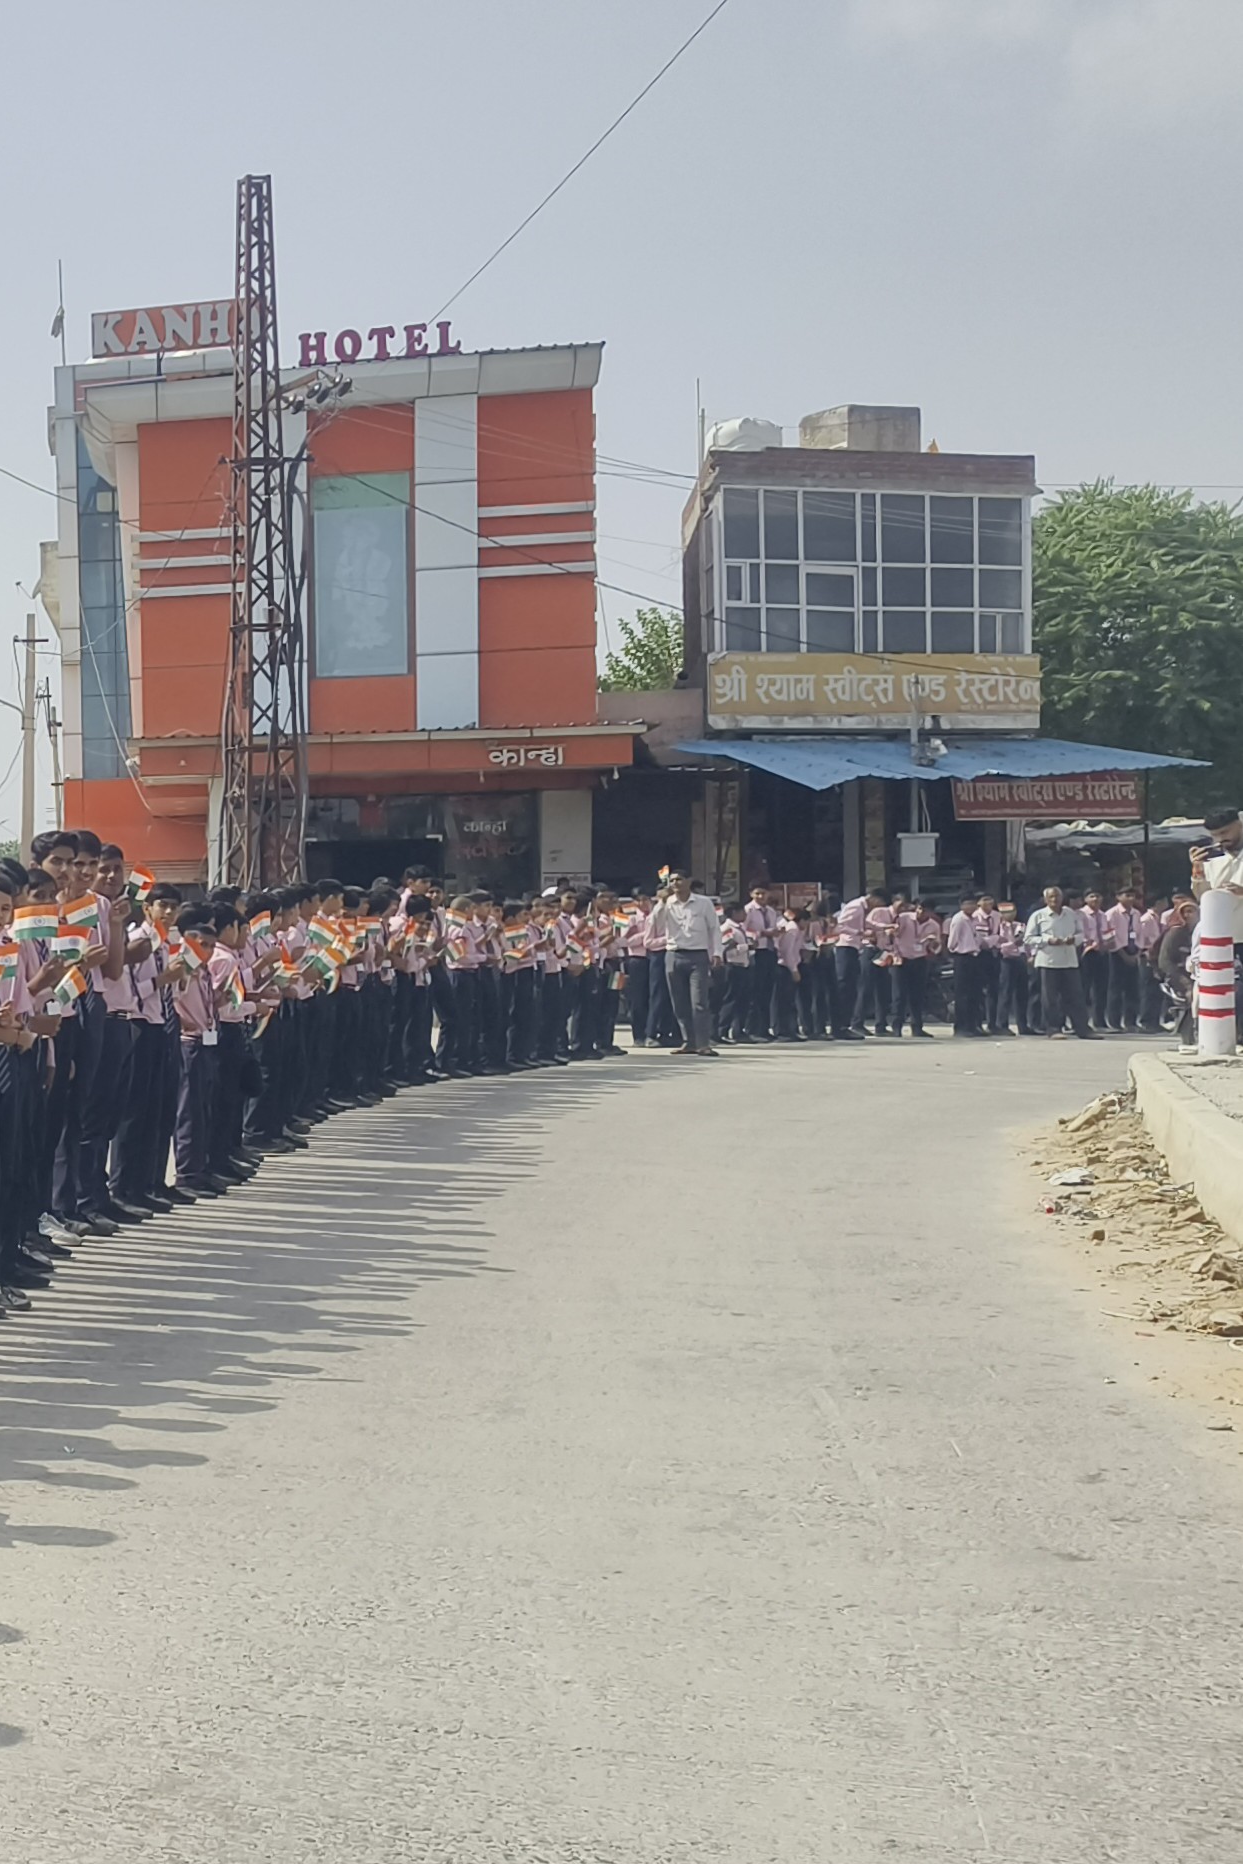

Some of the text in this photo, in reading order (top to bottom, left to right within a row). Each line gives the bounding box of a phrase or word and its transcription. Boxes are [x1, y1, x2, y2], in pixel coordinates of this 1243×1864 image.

[298, 321, 462, 367] HOTEL
[714, 665, 747, 704] श्री
[755, 674, 816, 704] श्याम
[822, 665, 895, 708] स्वीट्स
[488, 745, 565, 767] कान्हा
